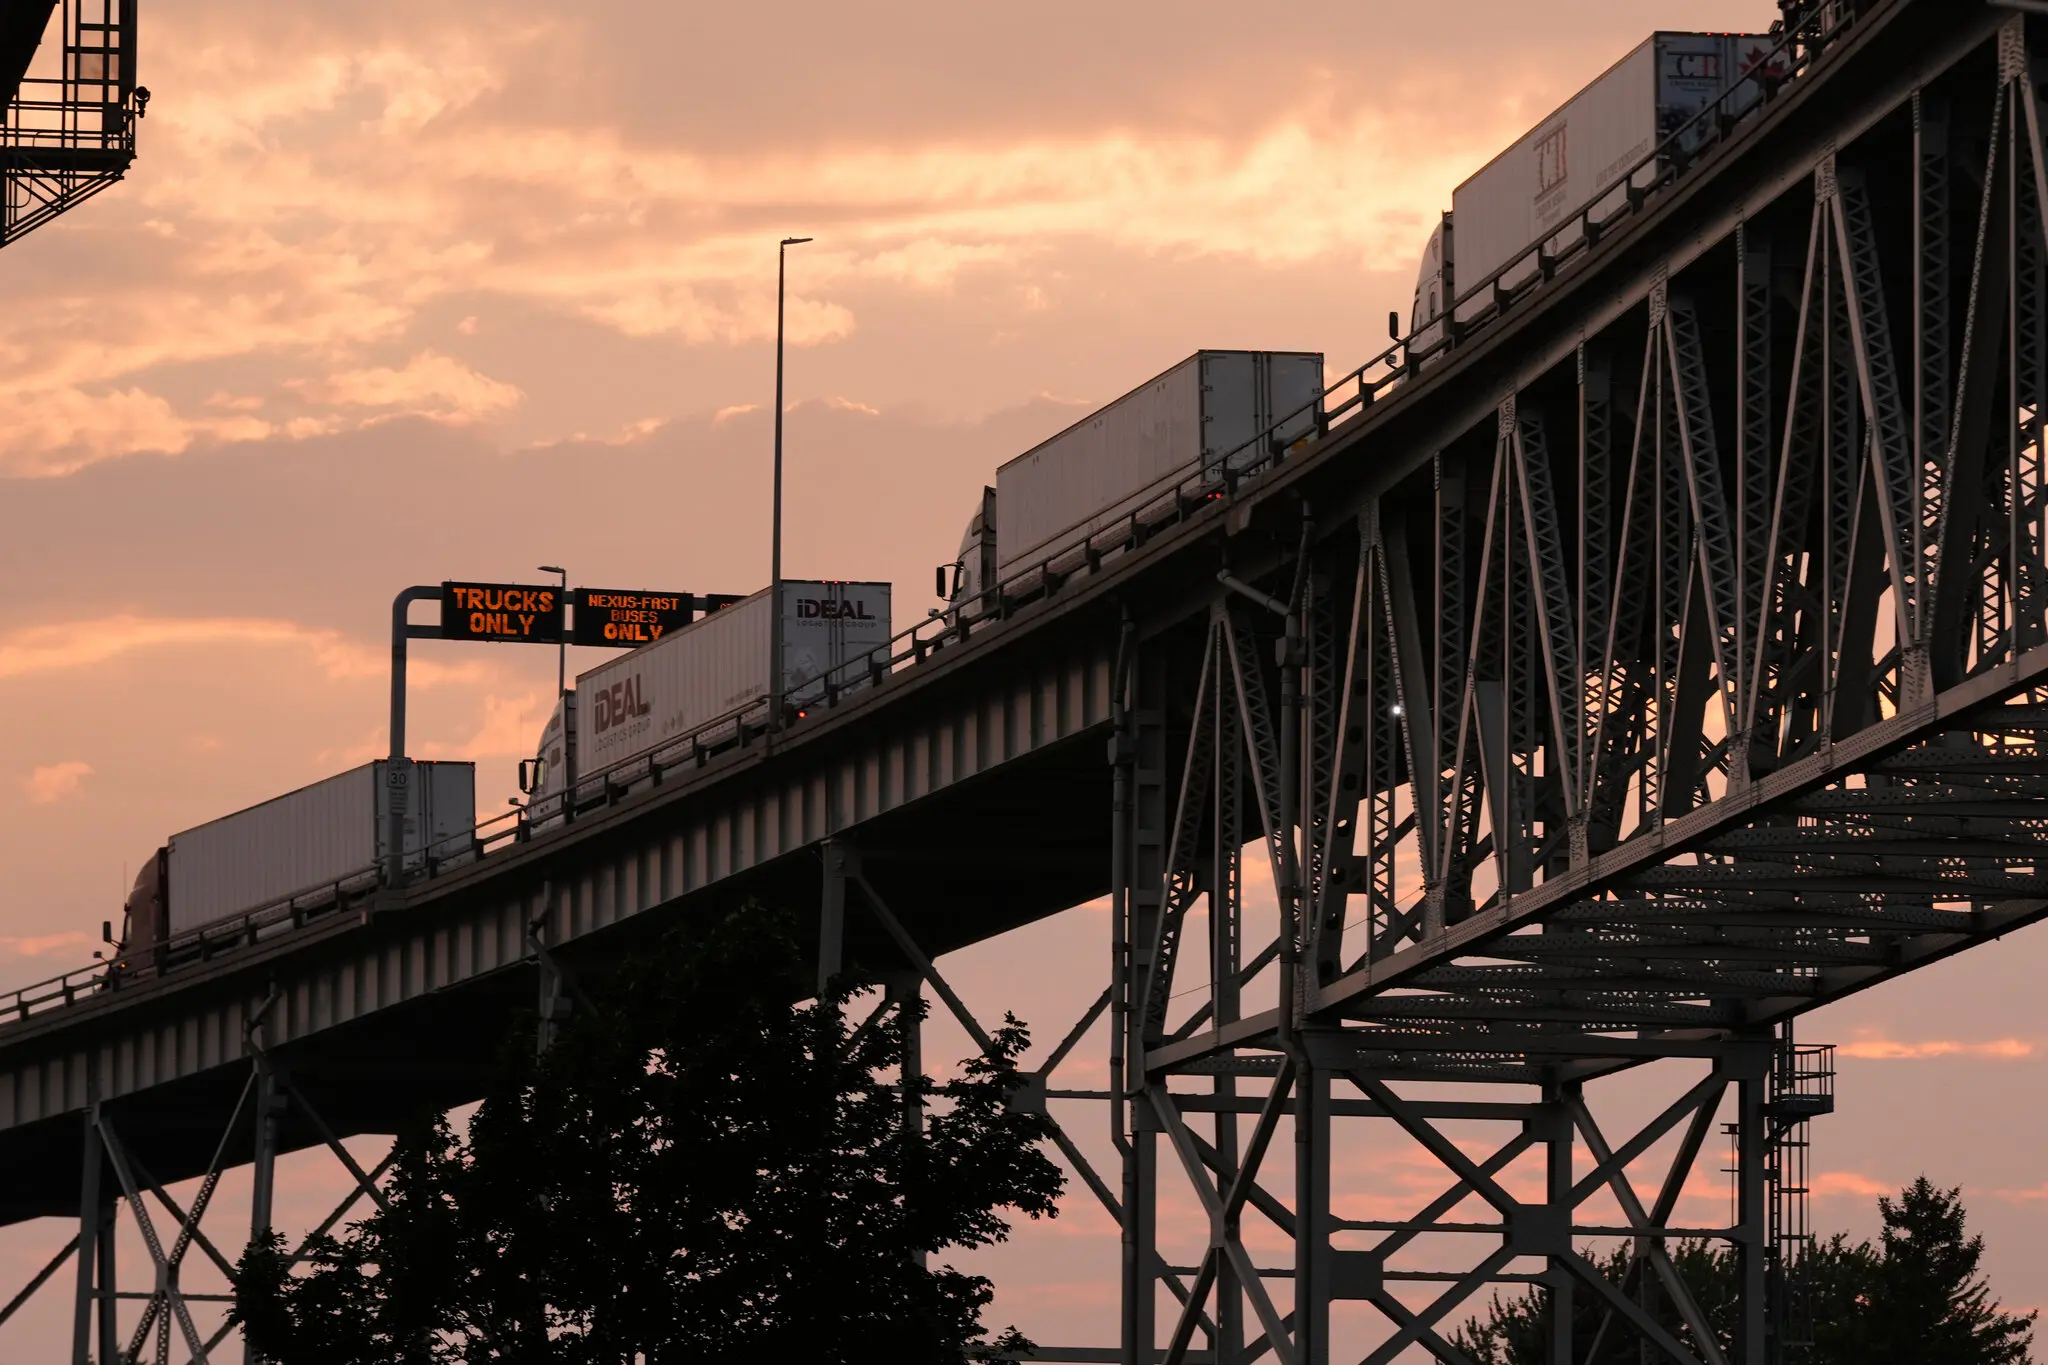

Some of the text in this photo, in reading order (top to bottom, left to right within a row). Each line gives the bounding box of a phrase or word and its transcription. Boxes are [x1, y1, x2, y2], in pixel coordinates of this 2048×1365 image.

[452, 587, 554, 613] TRUCKS
[588, 594, 679, 611] NEXUS-FAST
[469, 612, 535, 635] ONLY
[611, 610, 658, 624] BUSES
[603, 623, 663, 641] ONLY
[390, 772, 407, 785] 30
